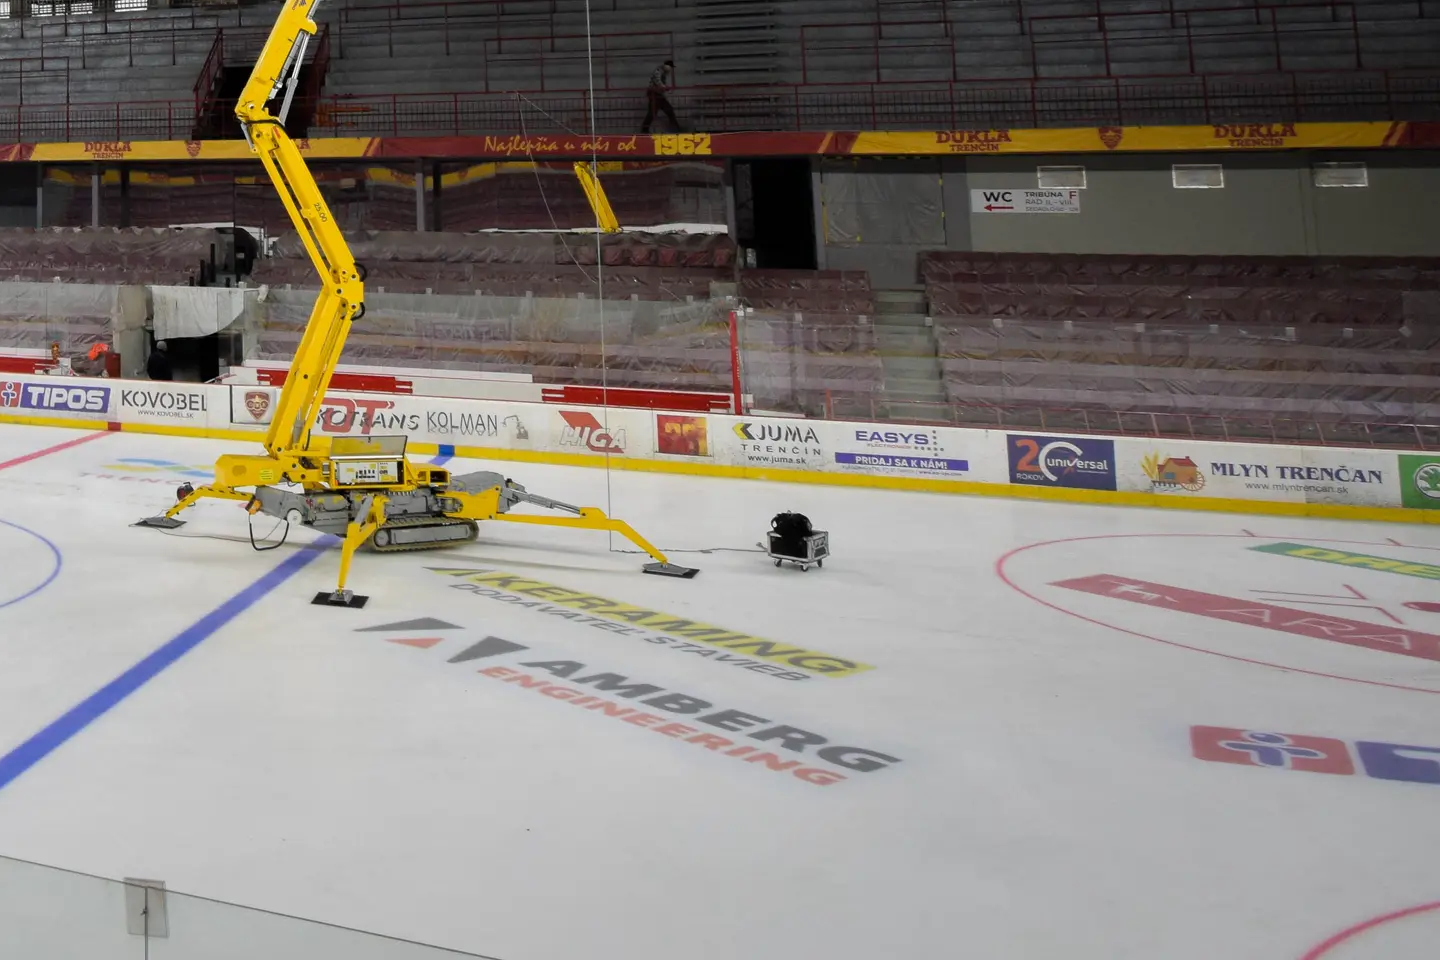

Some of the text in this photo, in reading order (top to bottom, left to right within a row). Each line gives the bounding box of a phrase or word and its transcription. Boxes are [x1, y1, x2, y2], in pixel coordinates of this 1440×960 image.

[936, 129, 1012, 144] DUKLA
[1213, 123, 1298, 139] DUKLA
[84, 141, 132, 153] DUKLA
[484, 133, 712, 156] Najlepšia u nás od 1962
[983, 191, 1013, 203] WC
[1069, 191, 1077, 199] F
[27, 386, 105, 411] TIPOS
[121, 390, 208, 412] KOVOBEL
[426, 411, 498, 435] KOLMAN
[855, 430, 929, 445] EASYS
[748, 455, 807, 465] www.juma.sk
[855, 455, 892, 466] PRIDAJ
[894, 457, 909, 467] SA
[910, 458, 918, 468] K
[920, 458, 948, 470] NÁM!
[1047, 457, 1109, 470] universal
[1210, 462, 1383, 484] MLYN TRENČAN
[476, 573, 858, 675] KERAMING
[643, 636, 813, 682] STAVIEB
[477, 664, 849, 787] ENGINEERING
[518, 659, 904, 773] AMBERG
